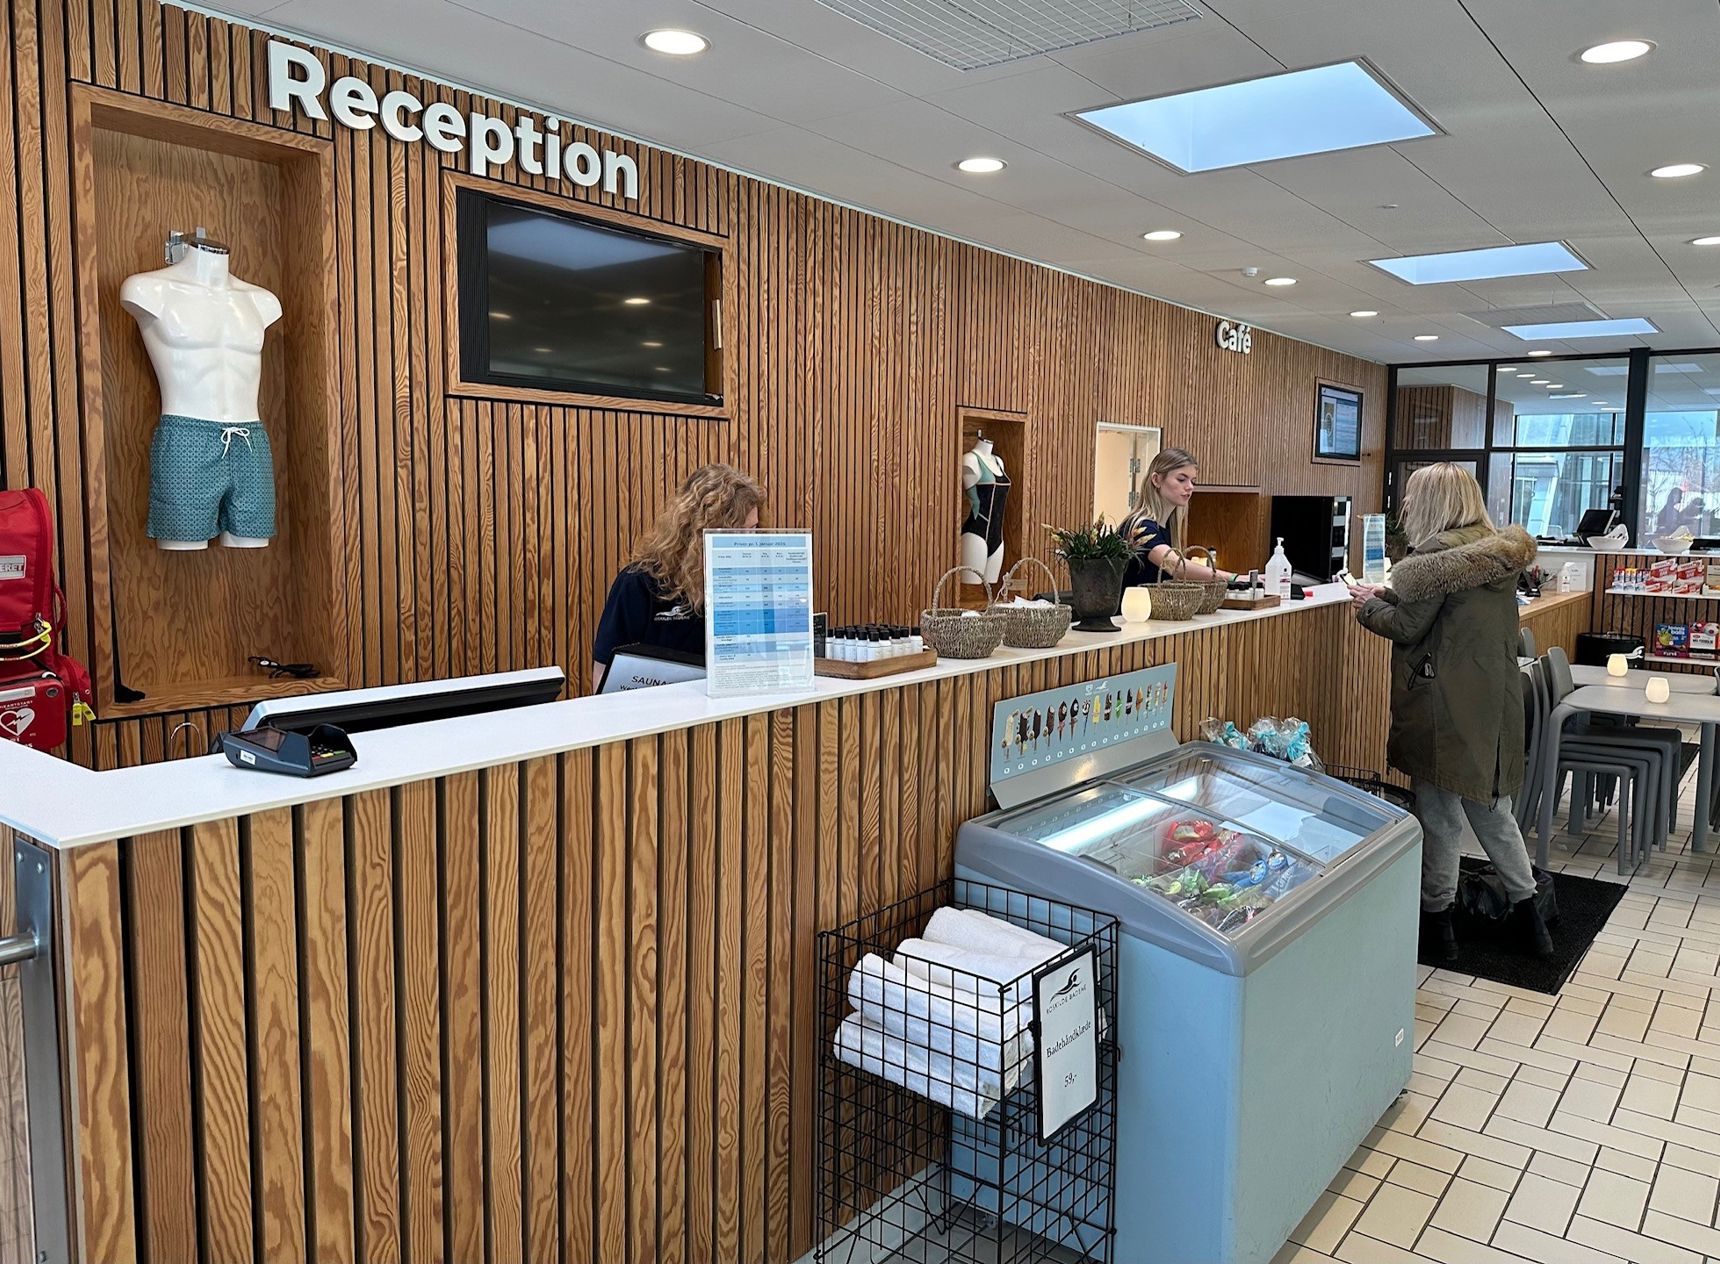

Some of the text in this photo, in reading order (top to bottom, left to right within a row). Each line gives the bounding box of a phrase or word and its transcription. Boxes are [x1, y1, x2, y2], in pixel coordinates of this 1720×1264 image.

[268, 39, 639, 200] Reception
[1216, 320, 1252, 355] Café
[632, 675, 670, 686] SAUNA
[1046, 1020, 1091, 1058] Badehåndklæde
[1064, 1072, 1077, 1088] 59,-
